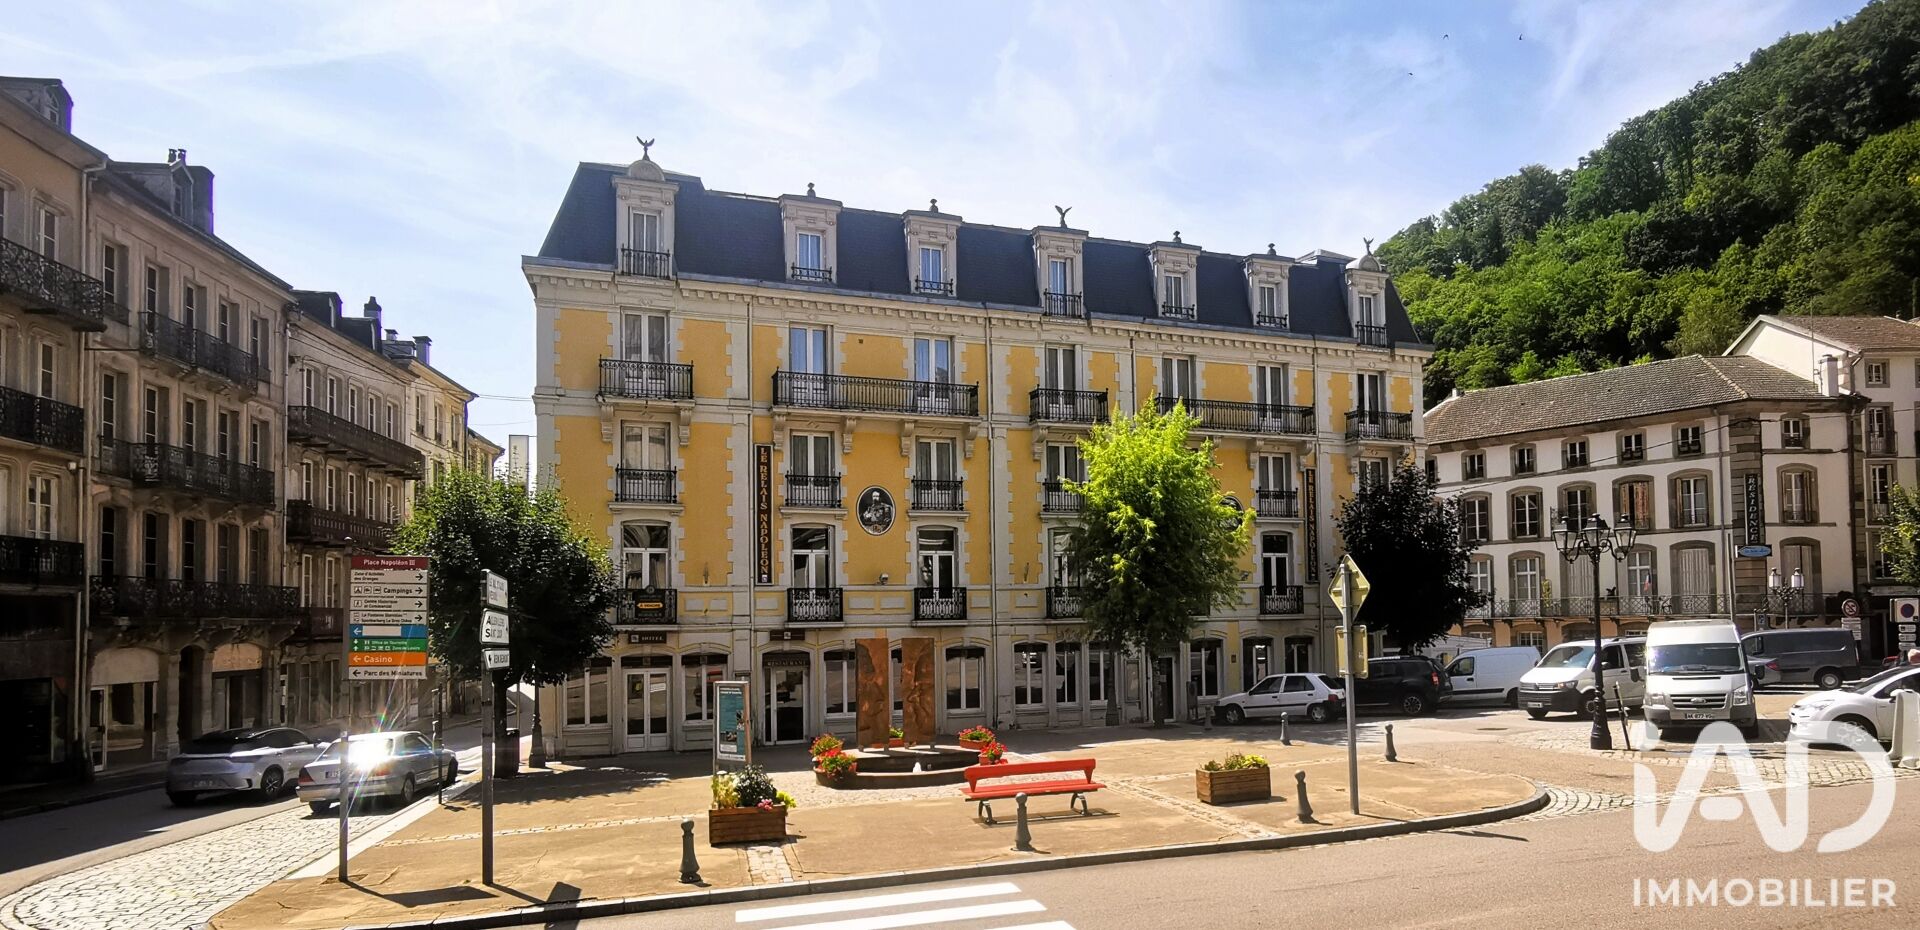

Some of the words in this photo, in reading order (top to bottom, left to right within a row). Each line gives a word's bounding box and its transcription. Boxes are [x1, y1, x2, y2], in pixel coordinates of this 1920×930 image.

[760, 447, 767, 462] LE
[760, 465, 768, 510] RELAIS
[760, 514, 769, 574] NAPOLEON
[380, 559, 408, 567] Napoléon
[383, 587, 413, 595] Campings
[363, 655, 393, 663] Casino
